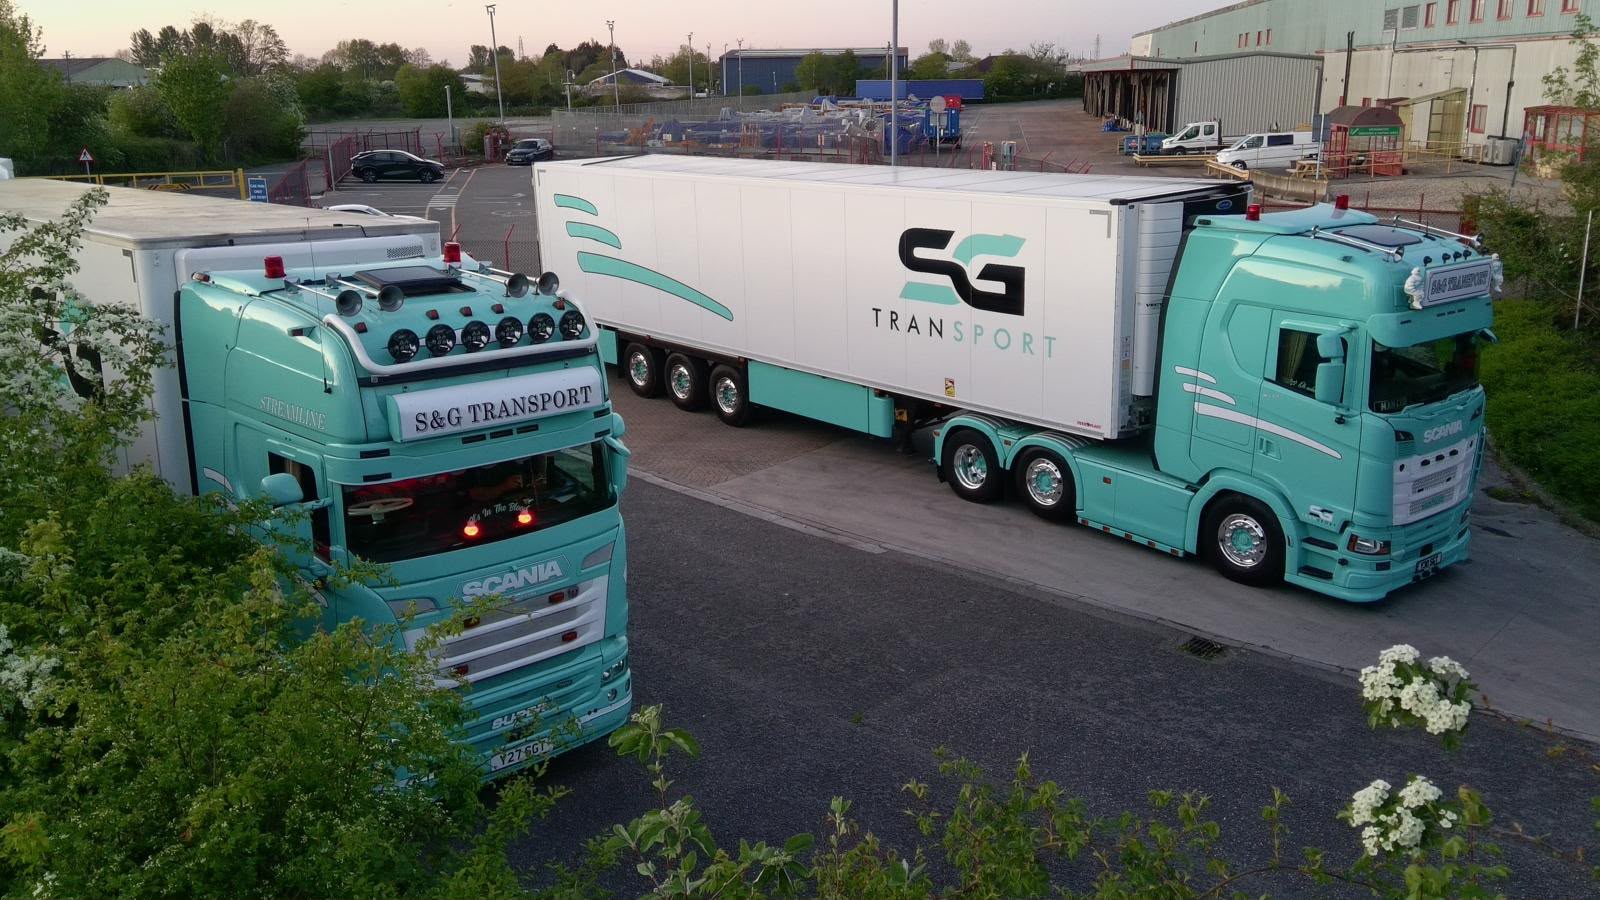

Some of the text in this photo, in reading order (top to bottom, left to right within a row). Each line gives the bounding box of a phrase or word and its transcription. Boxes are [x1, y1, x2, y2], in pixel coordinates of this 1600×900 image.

[898, 227, 1026, 317] SG
[872, 308, 1056, 358] TRANSPORT
[259, 396, 327, 431] STREAMLINE
[415, 385, 593, 432] S&G TRANSPORT
[1423, 419, 1463, 443] SCANIA
[462, 559, 563, 602] SCANIA
[500, 749, 522, 766] Y27
